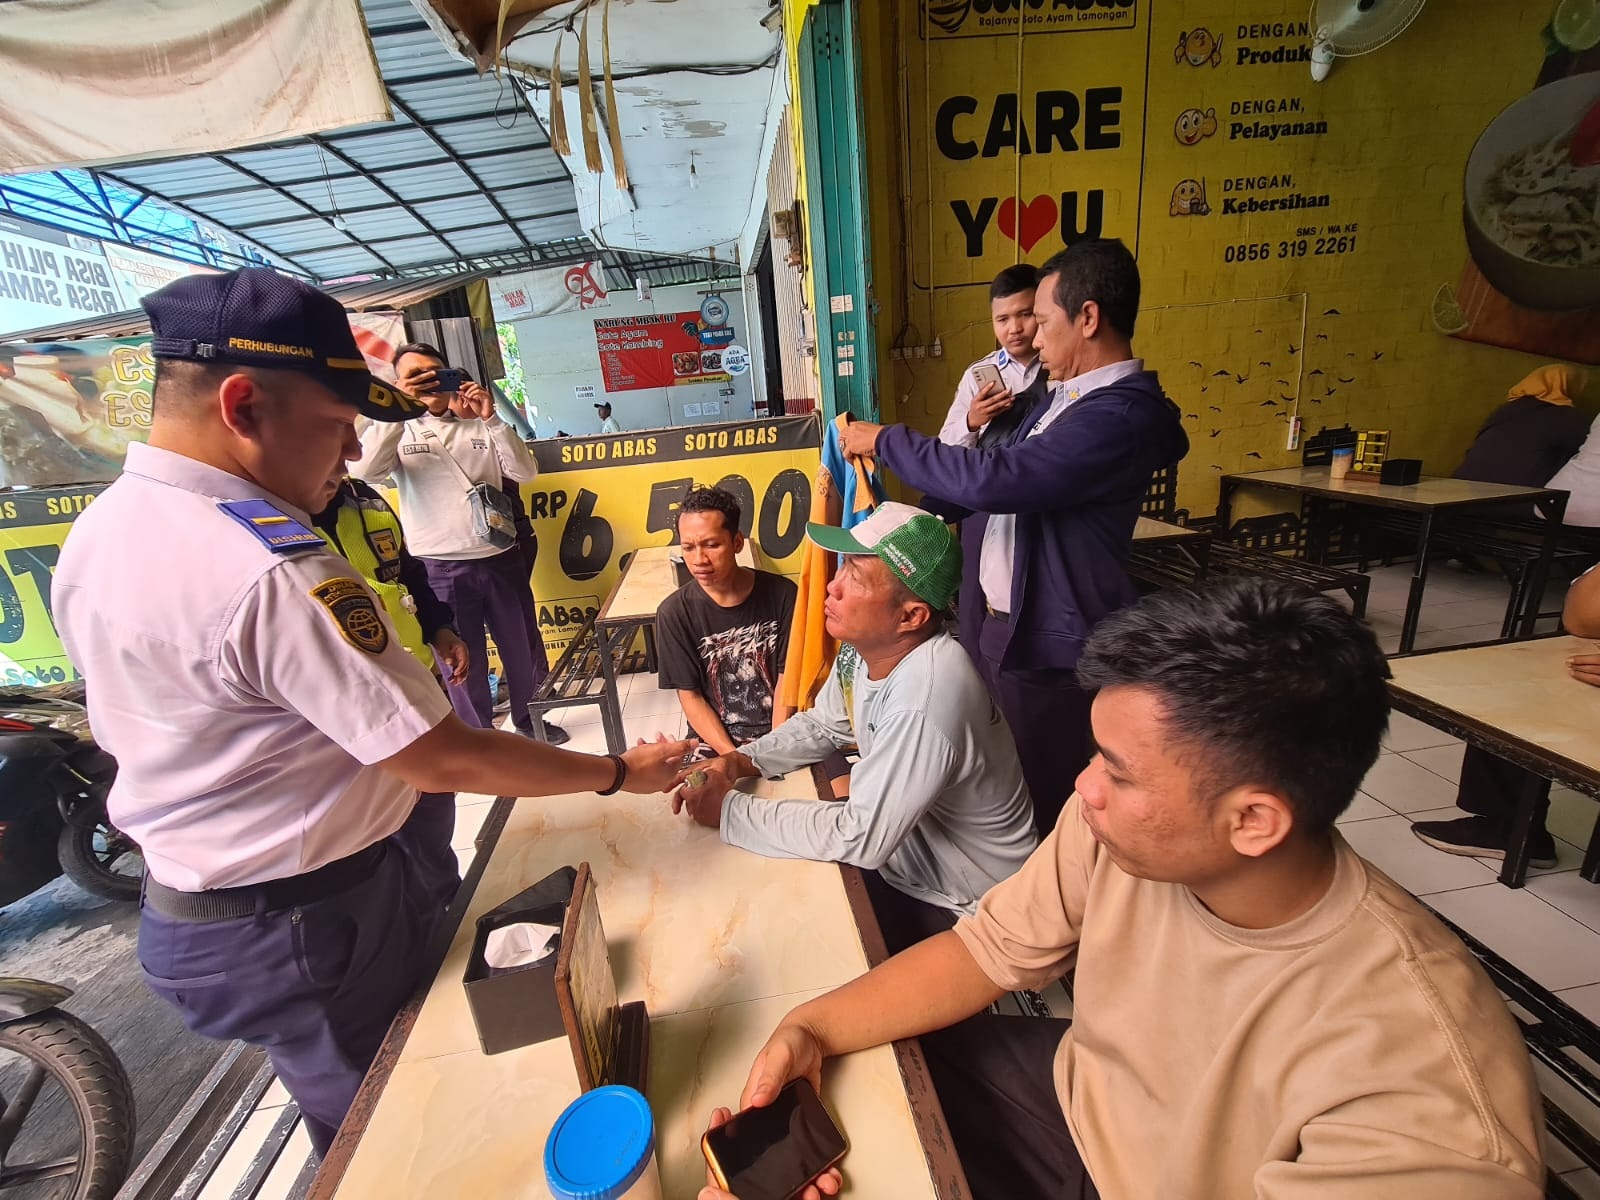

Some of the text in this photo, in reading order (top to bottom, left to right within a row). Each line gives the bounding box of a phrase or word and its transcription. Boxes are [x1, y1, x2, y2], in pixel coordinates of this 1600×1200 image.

[979, 15, 1018, 26] Rajanya
[1047, 14, 1073, 25] Ayam
[1077, 10, 1128, 21] Lamongan
[1236, 44, 1312, 65] Produk
[1230, 98, 1305, 115] DENGAN,
[936, 86, 1122, 160] CARE
[1230, 121, 1328, 141] Pelayanan
[1223, 174, 1296, 191] DENGAN,
[1222, 193, 1330, 215] Kebersihan
[1296, 227, 1316, 237] SMS
[1327, 225, 1341, 234] WA
[1345, 223, 1358, 232] KE
[1225, 236, 1357, 263] 0856 319 2261
[229, 337, 315, 358] PERHUBUNGAN
[562, 426, 778, 463] SOTO ABAS SOTO ABAS
[531, 490, 567, 519] RP
